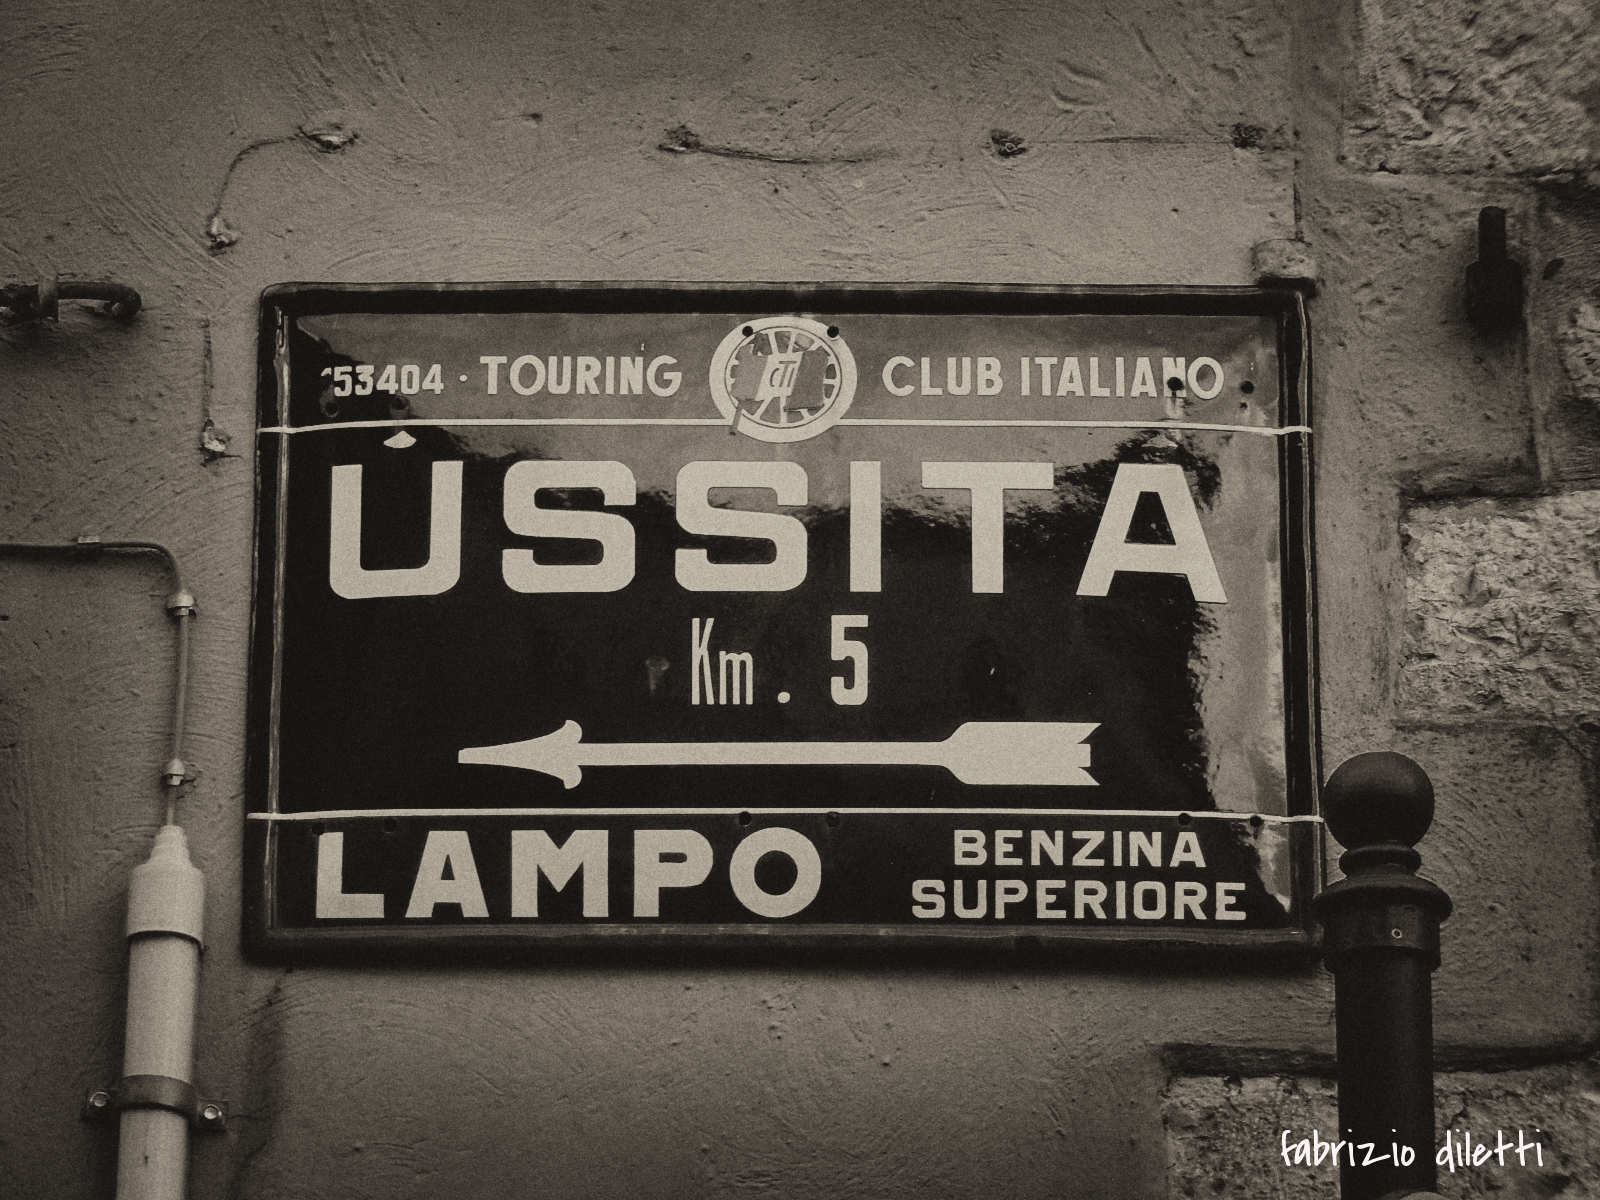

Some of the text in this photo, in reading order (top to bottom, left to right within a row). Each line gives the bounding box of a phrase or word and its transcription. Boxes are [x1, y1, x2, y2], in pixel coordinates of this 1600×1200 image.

[320, 354, 1225, 400] 53404 TOURING CLUB ITALIANO
[329, 459, 1227, 604] USSITA
[830, 614, 869, 706] 5
[315, 826, 822, 920] LAMPO
[953, 829, 1207, 868] BENZINA
[911, 879, 1247, 921] SUPERIORE
